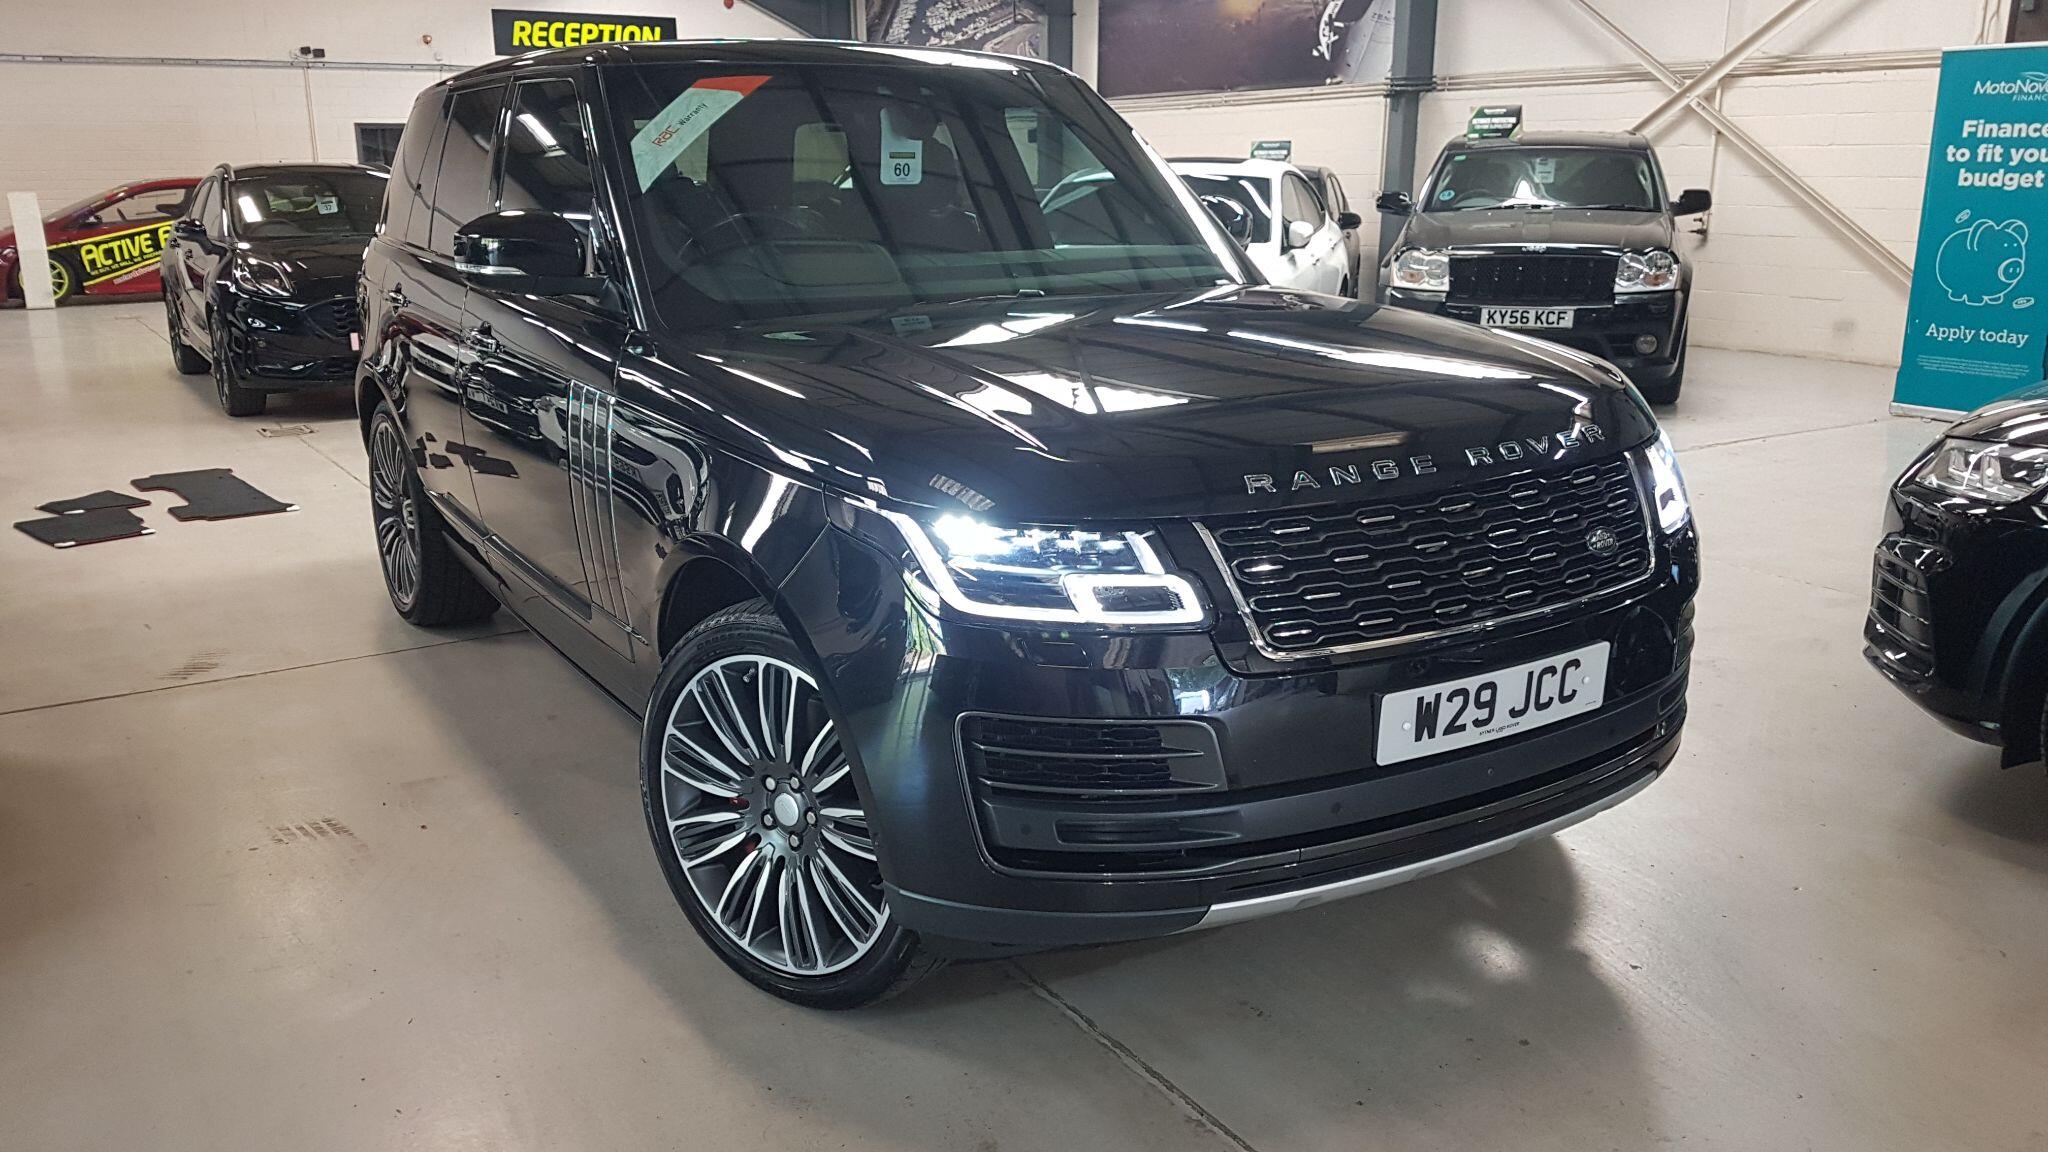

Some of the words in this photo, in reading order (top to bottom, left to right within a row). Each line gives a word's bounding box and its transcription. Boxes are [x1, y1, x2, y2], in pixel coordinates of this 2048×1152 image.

[512, 20, 662, 48] RECEPTION
[1973, 79, 2048, 95] MotoNov
[2012, 94, 2048, 102] FINANC
[677, 103, 708, 126] Warranty
[1946, 145, 1971, 163] to
[1977, 144, 2004, 163] fit
[2009, 147, 2048, 167] you
[894, 163, 910, 177] 60
[1958, 168, 2045, 191] budget
[80, 233, 154, 273] ACTIVE
[1486, 309, 1530, 325] KY56
[1534, 310, 1568, 326] KCF
[1925, 322, 1976, 343] Apply
[1979, 328, 2029, 349] today
[1243, 454, 1438, 495] RANGE
[1464, 424, 1606, 467] ROVER
[1414, 680, 1498, 743] W29
[1508, 658, 1581, 719] JCC
